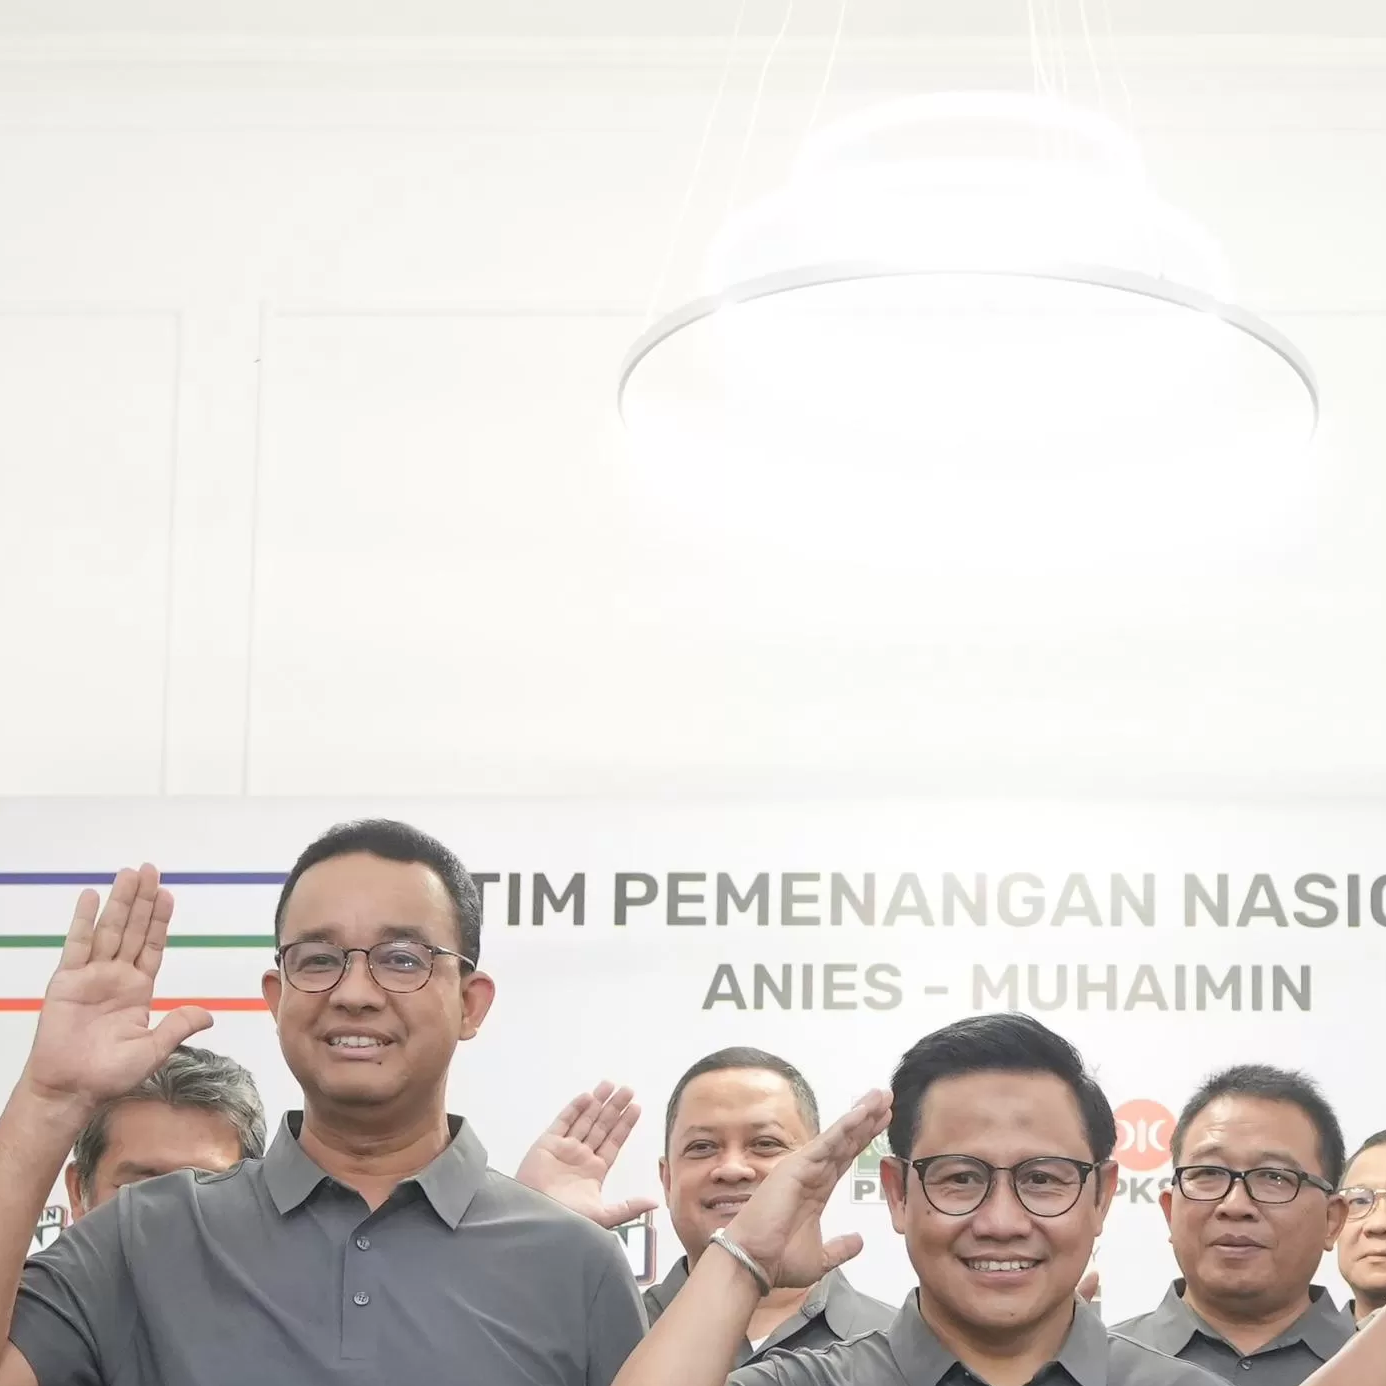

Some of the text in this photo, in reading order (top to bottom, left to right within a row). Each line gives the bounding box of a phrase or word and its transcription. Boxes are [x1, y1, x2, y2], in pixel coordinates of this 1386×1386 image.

[469, 872, 586, 926] TIM
[614, 872, 1156, 928] PEMENANGAN
[702, 963, 1311, 1012] ANIES - MUHAIMIN
